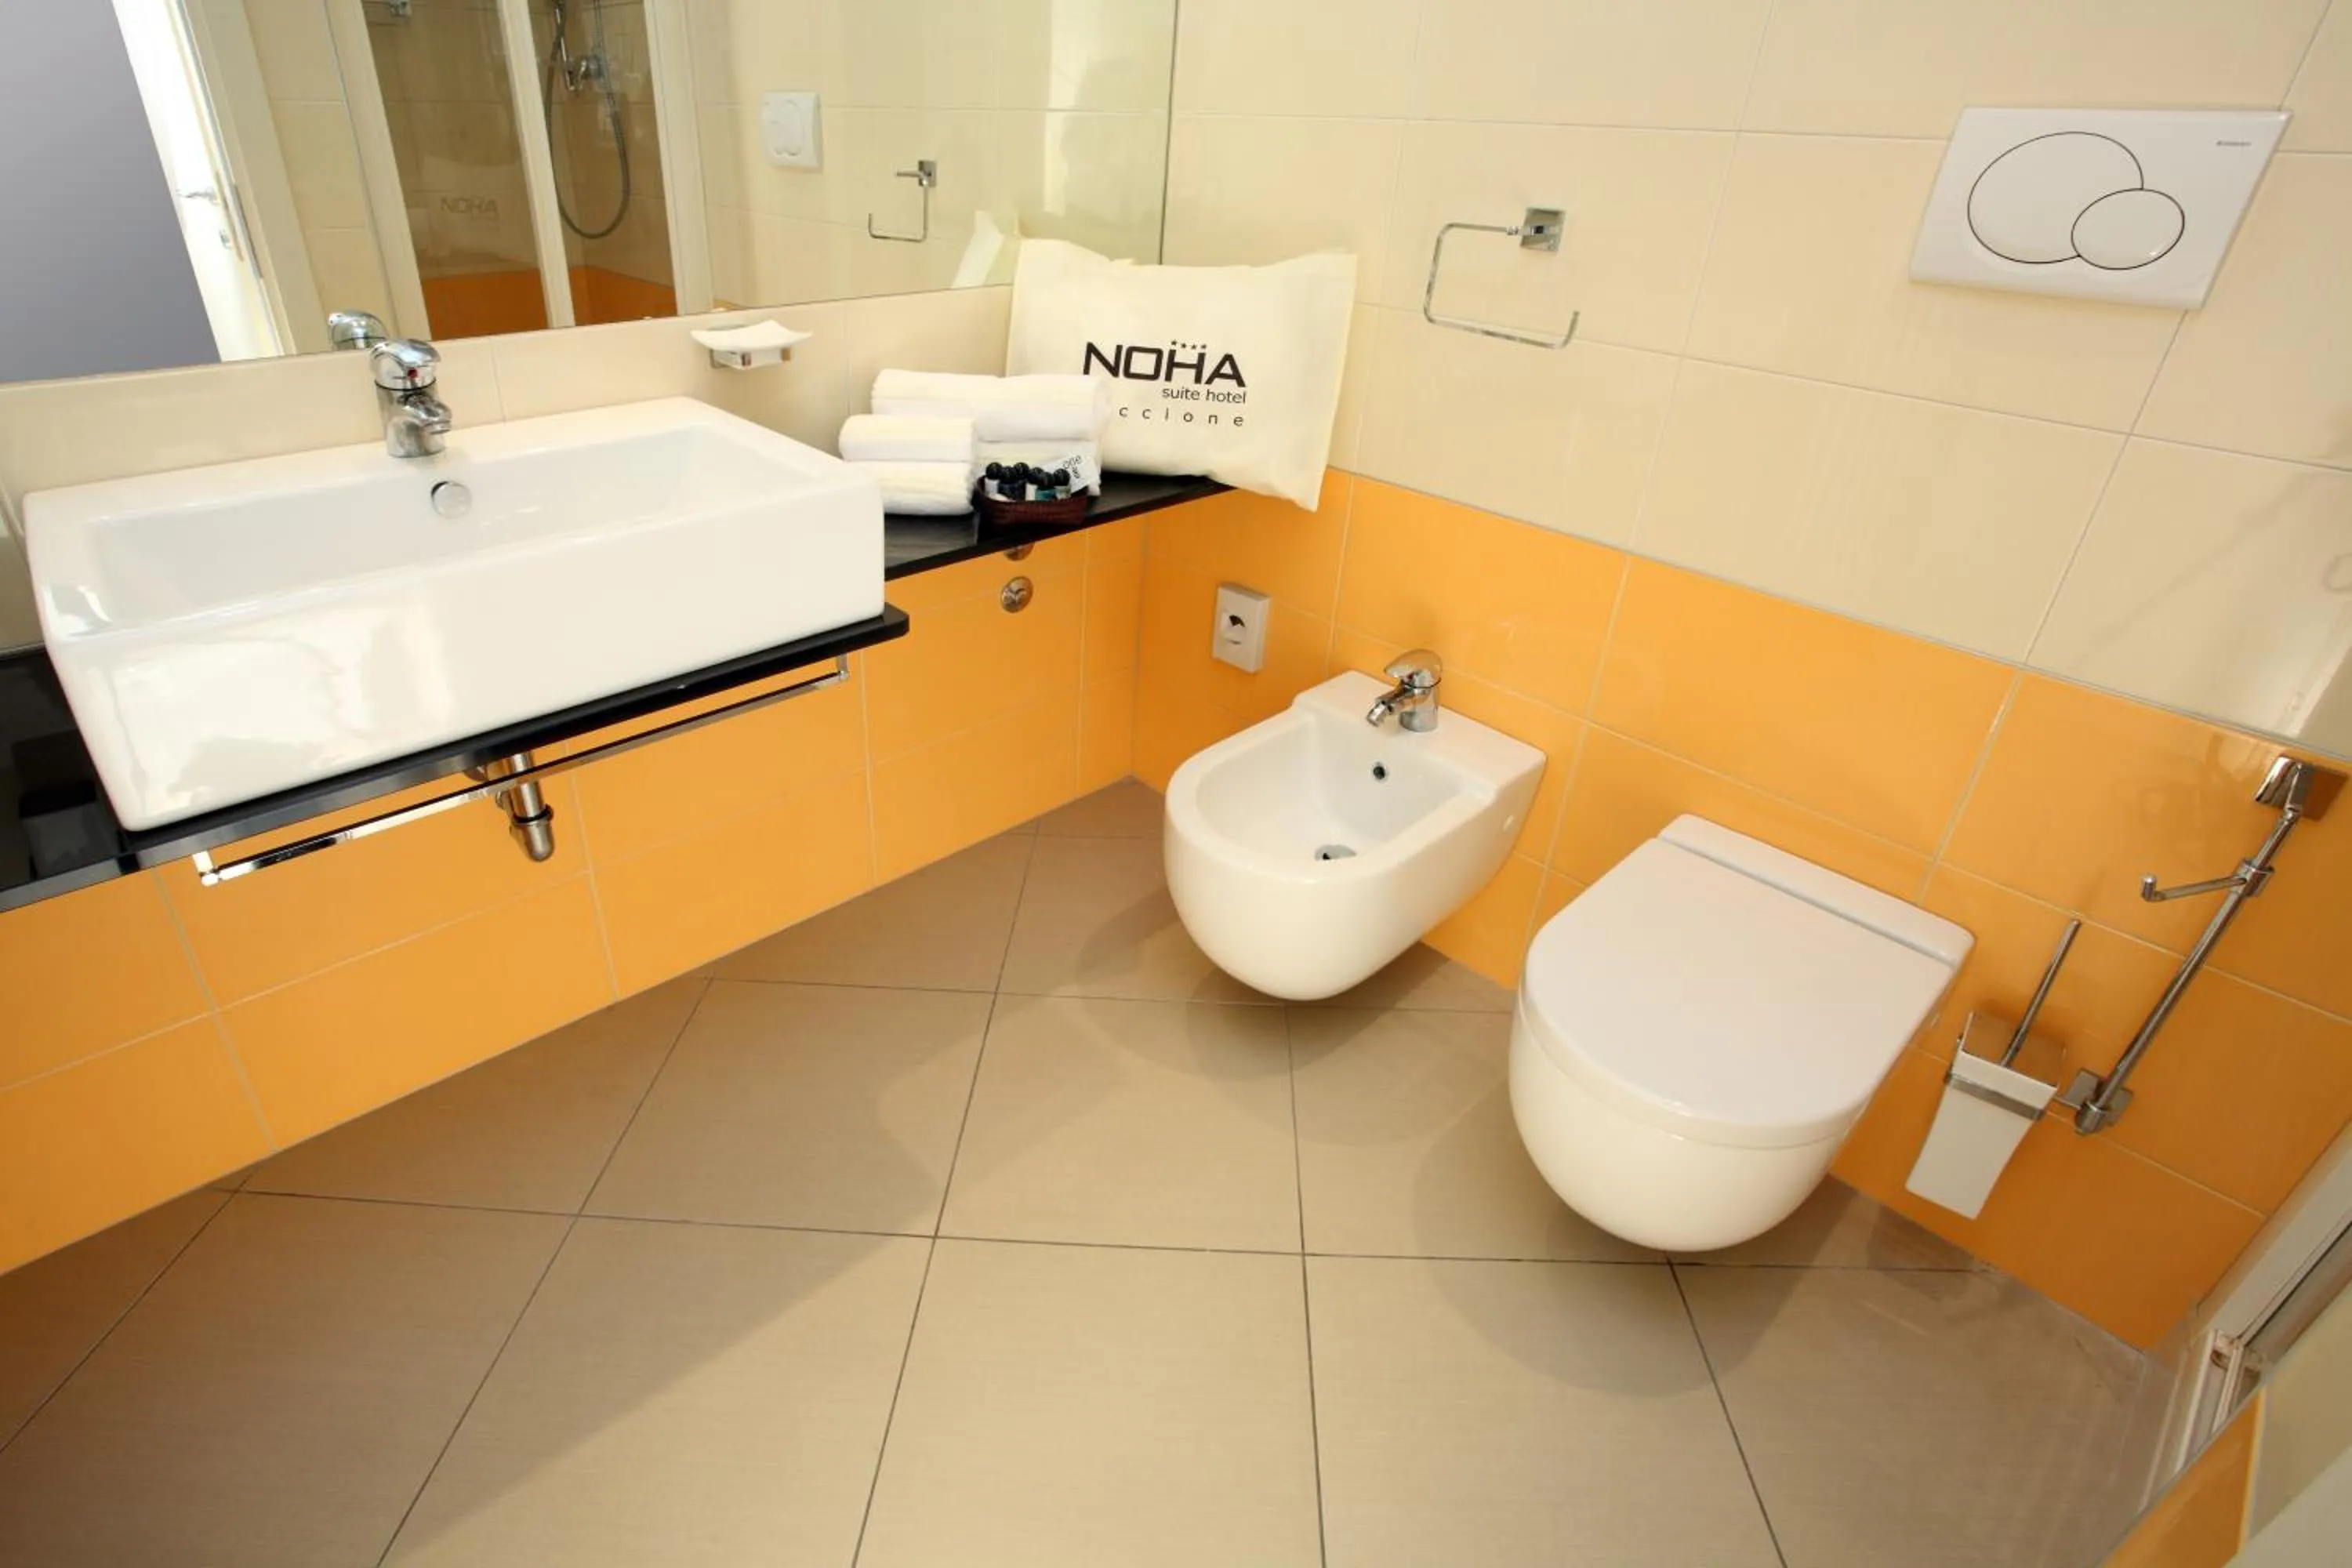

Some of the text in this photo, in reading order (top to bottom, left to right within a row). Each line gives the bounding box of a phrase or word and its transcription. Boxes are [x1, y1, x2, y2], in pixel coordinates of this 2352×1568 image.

[1083, 341, 1247, 387] NOHA
[1162, 387, 1247, 405] suite hotel
[1118, 406, 1244, 426] ccione
